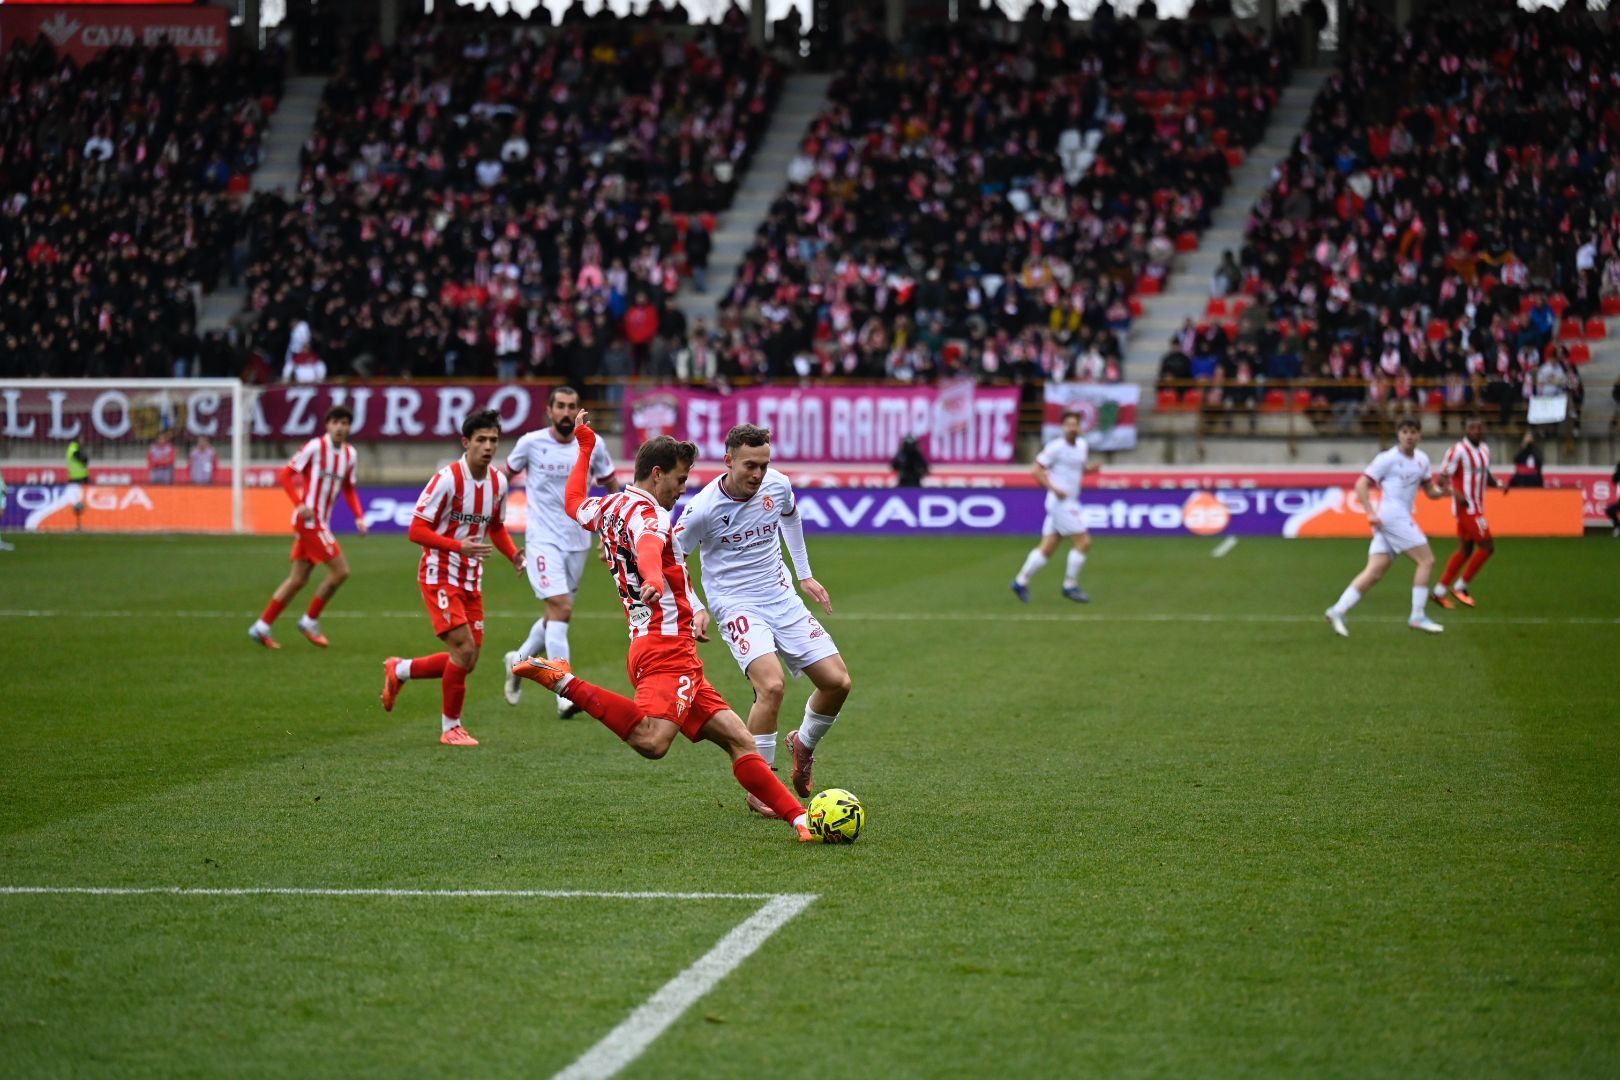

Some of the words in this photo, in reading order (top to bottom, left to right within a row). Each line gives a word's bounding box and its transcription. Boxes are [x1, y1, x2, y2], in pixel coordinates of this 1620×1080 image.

[82, 25, 136, 46] CAJA
[450, 511, 496, 525] SIROK
[797, 495, 1006, 528] AVADO
[537, 555, 546, 572] 6
[437, 589, 448, 610] 6
[727, 615, 749, 643] 20
